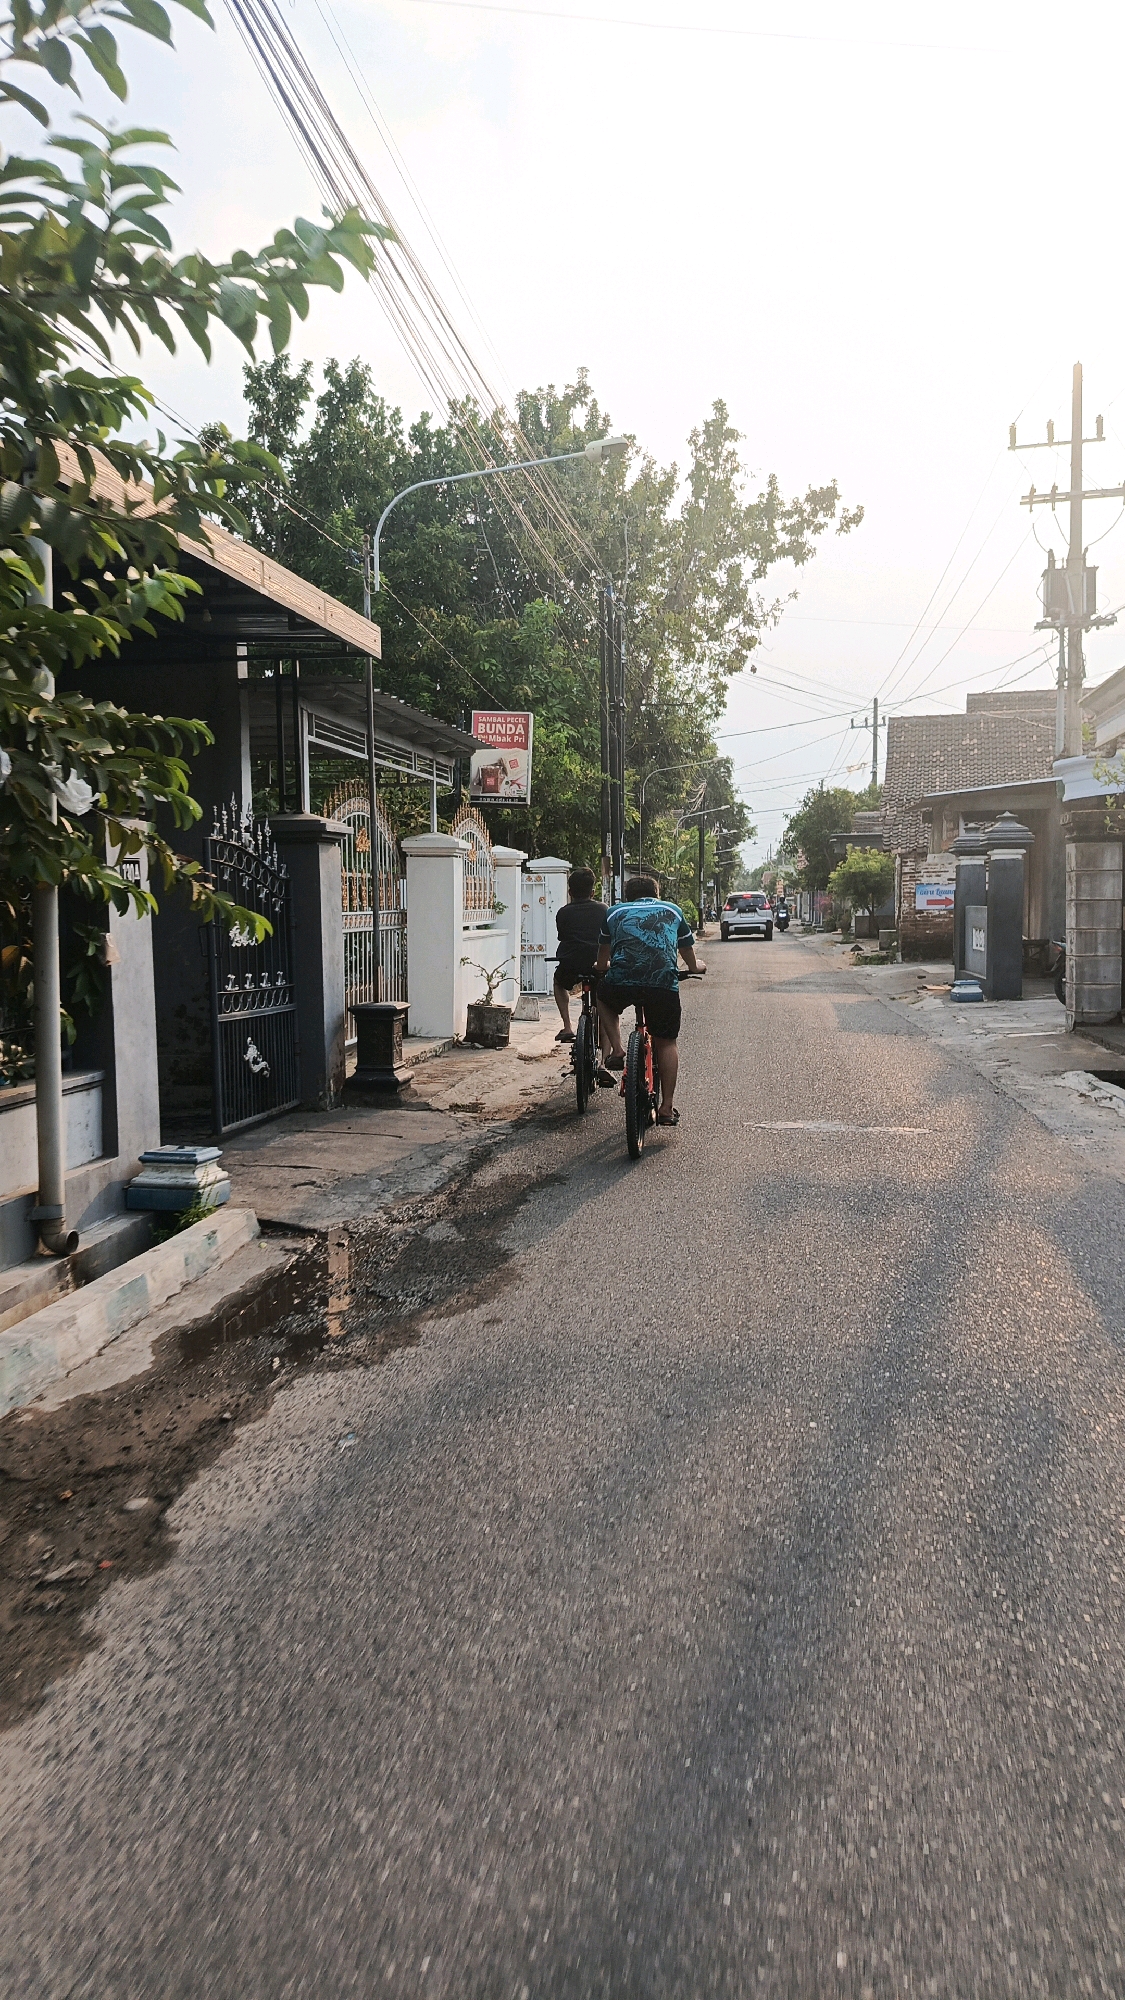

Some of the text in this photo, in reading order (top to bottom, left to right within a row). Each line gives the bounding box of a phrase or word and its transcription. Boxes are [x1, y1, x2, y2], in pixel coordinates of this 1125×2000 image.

[477, 723, 525, 735] BUNDA
[488, 735, 512, 743] Mbak
[513, 735, 525, 743] Pri
